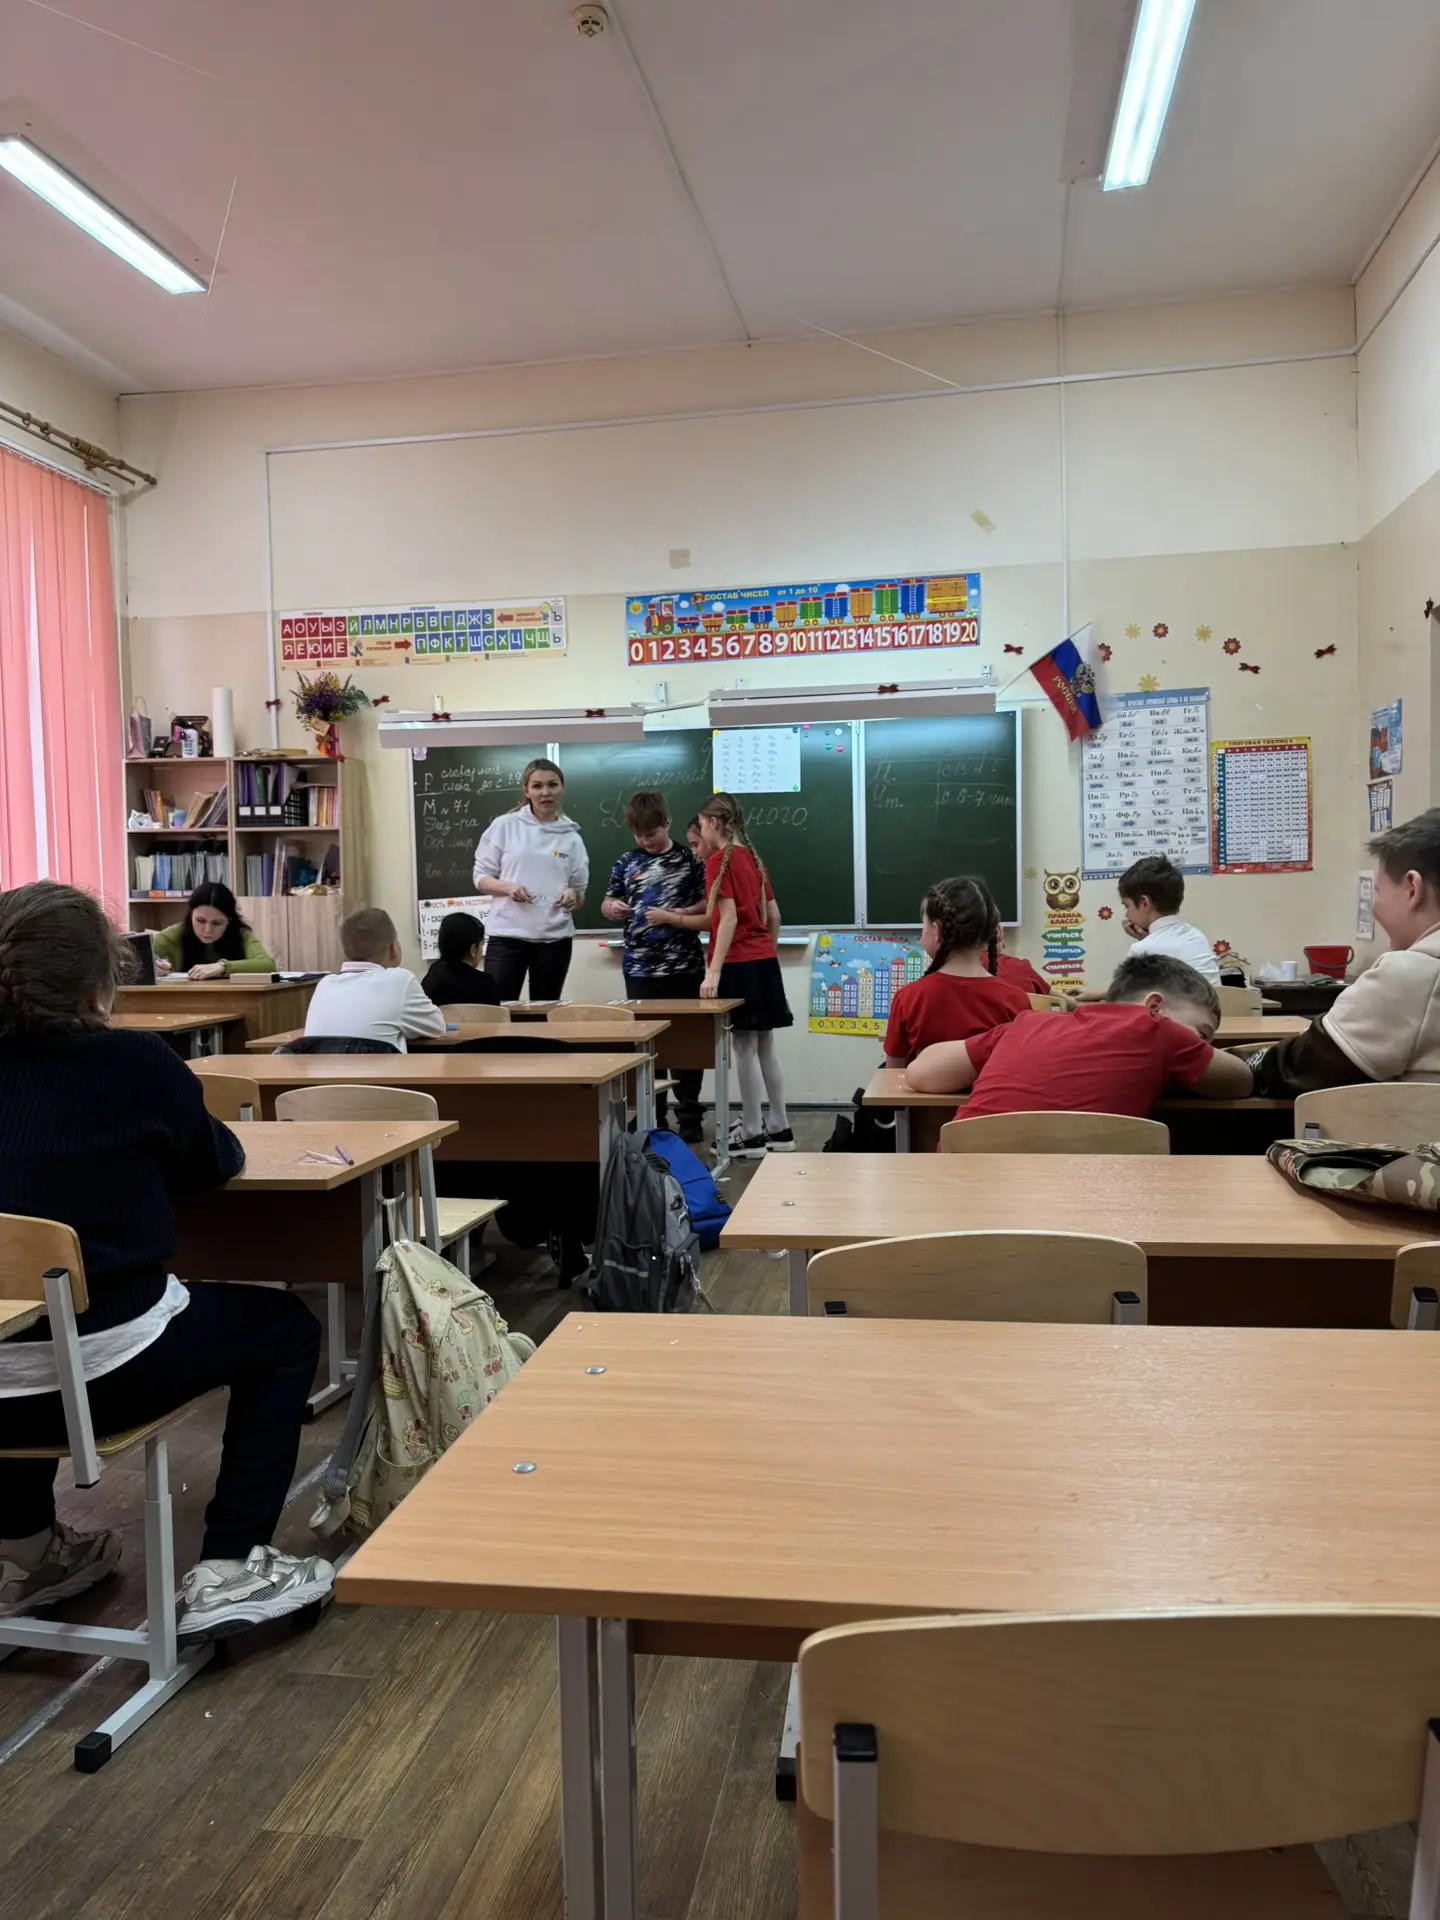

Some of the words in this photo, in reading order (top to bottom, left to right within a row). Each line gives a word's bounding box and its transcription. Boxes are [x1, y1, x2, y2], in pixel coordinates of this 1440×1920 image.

[704, 591, 738, 601] СОСТАВ
[740, 589, 769, 598] ЧИСЕЛ
[630, 643, 643, 662] 0
[649, 641, 658, 660] 1
[662, 640, 675, 660] 2
[678, 639, 691, 658] 3
[694, 638, 708, 658] 4
[710, 637, 723, 656] 5
[727, 636, 740, 656] 6
[743, 635, 756, 654] 7
[759, 634, 772, 654] 8
[775, 633, 789, 652] 9
[790, 632, 806, 652] 10
[808, 631, 822, 650] 11
[824, 630, 840, 650] 12
[840, 629, 856, 648] 13
[858, 628, 874, 648] 14
[875, 626, 891, 646] 15
[892, 626, 908, 646] 16
[908, 625, 924, 644] 17
[926, 624, 942, 644] 18
[944, 623, 960, 642] 19
[961, 622, 978, 642] 20
